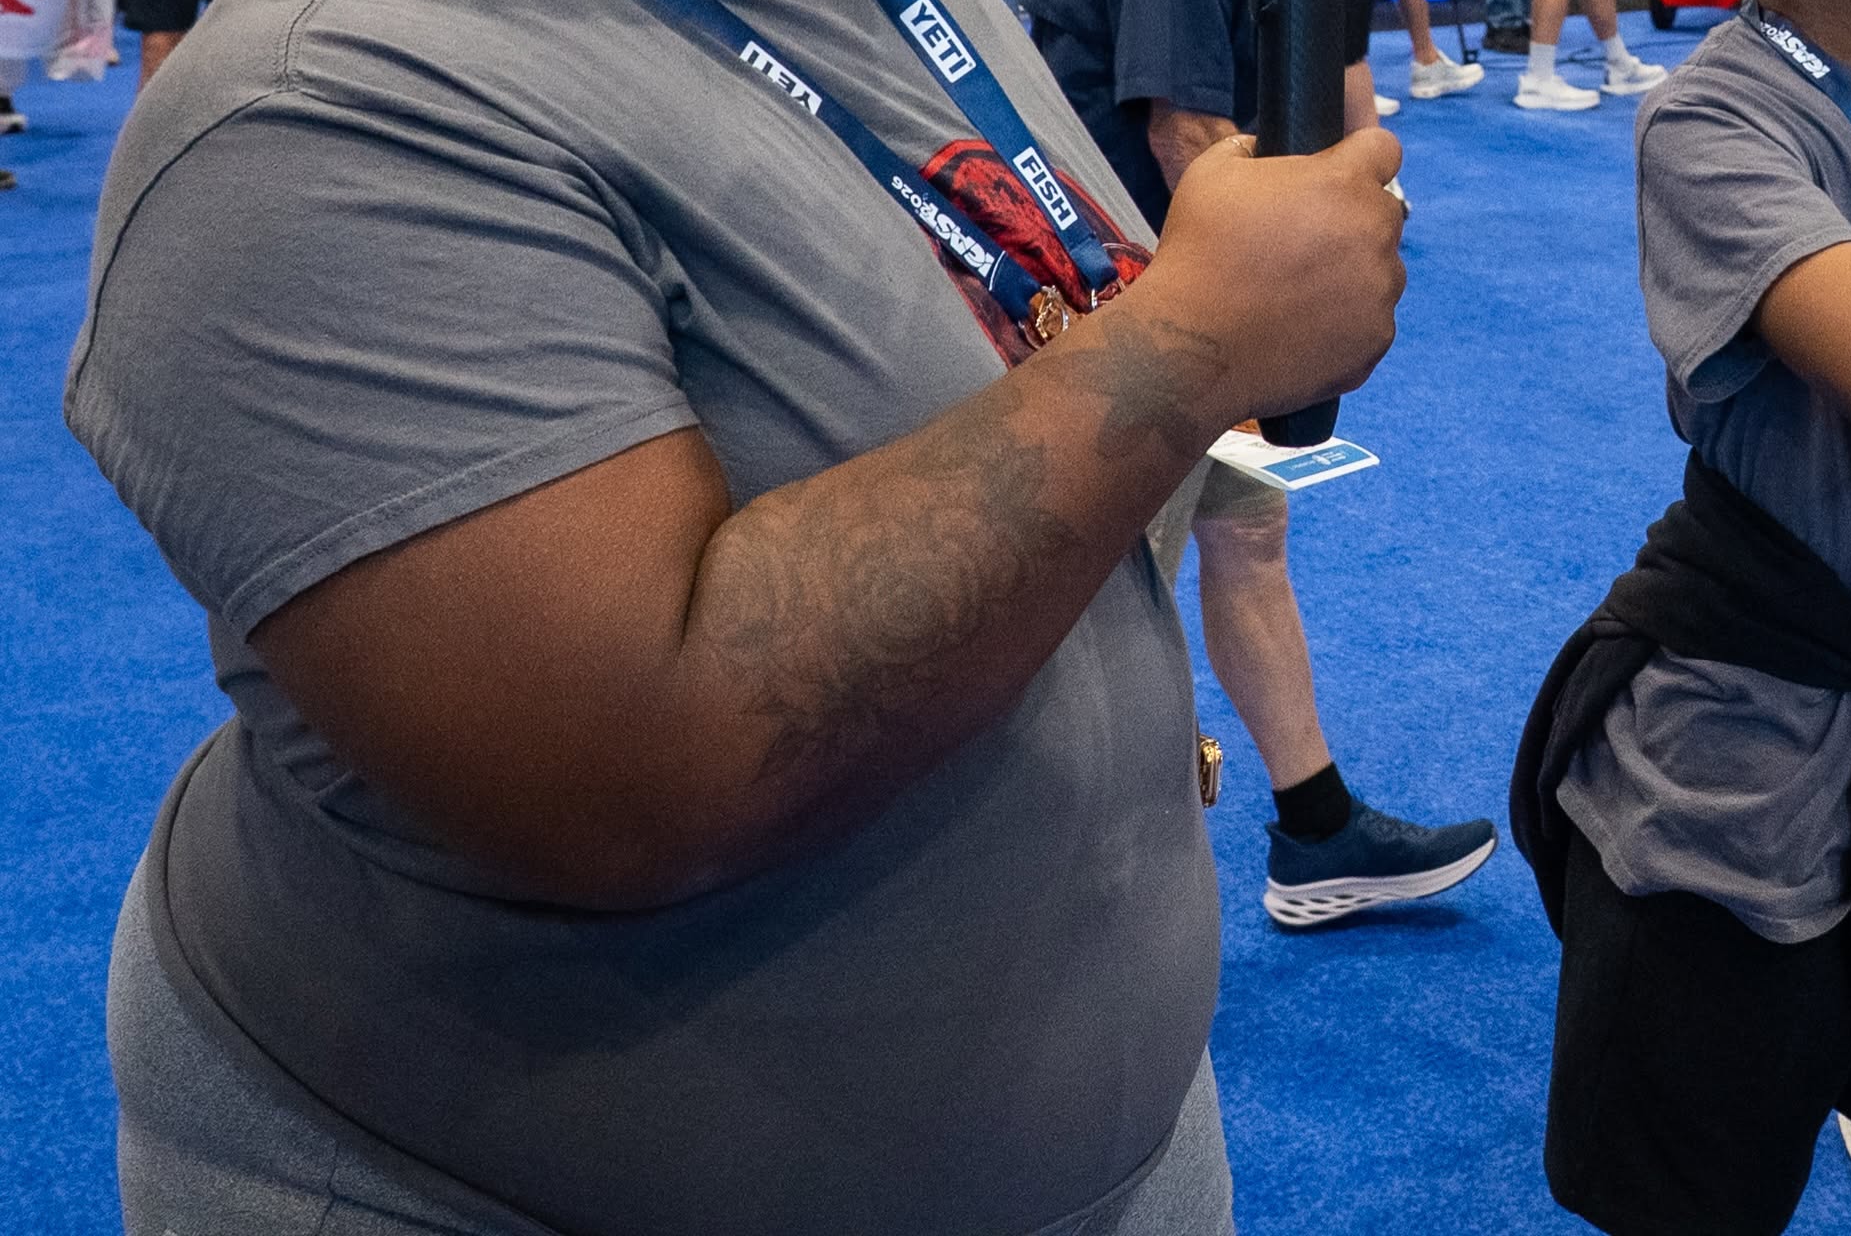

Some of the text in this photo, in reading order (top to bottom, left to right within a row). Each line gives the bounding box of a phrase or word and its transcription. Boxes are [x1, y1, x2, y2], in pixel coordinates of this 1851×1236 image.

[909, 1, 972, 76] YETI
[1018, 153, 1075, 224] FISH
[891, 175, 996, 278] ICAST 2026
